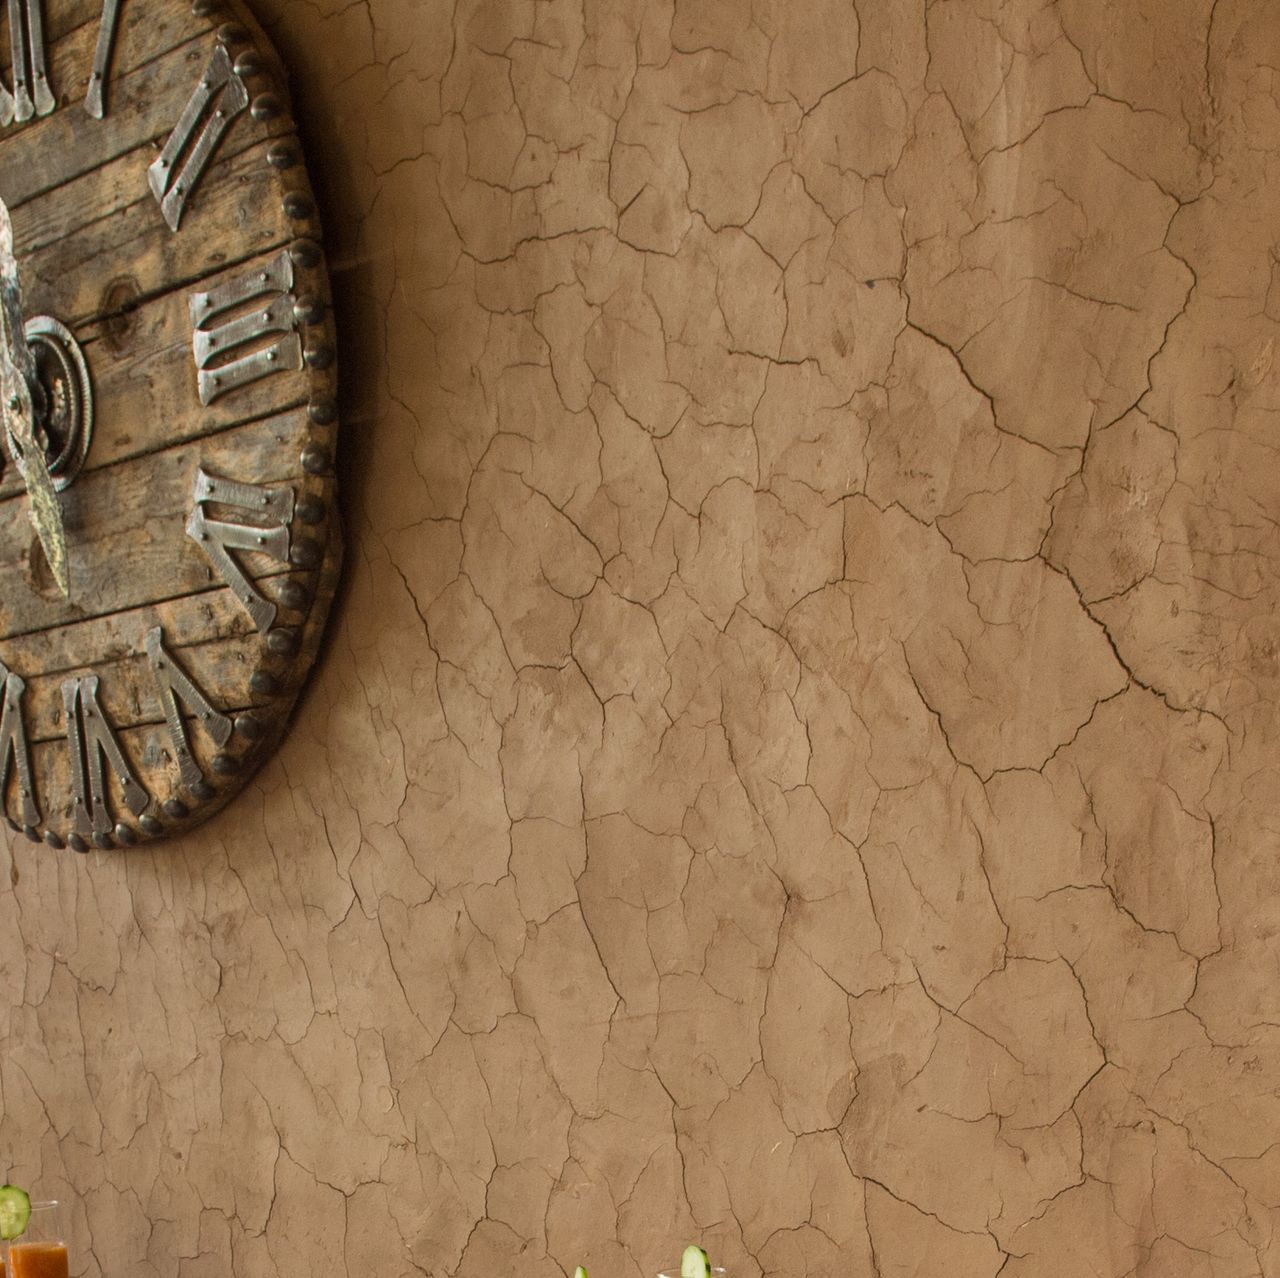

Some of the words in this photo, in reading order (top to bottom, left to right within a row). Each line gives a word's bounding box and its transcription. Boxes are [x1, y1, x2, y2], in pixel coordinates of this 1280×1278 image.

[147, 44, 248, 232] II
[188, 249, 303, 406] III
[186, 467, 295, 634] IV
[60, 675, 148, 833] VI
[144, 626, 232, 792] V
